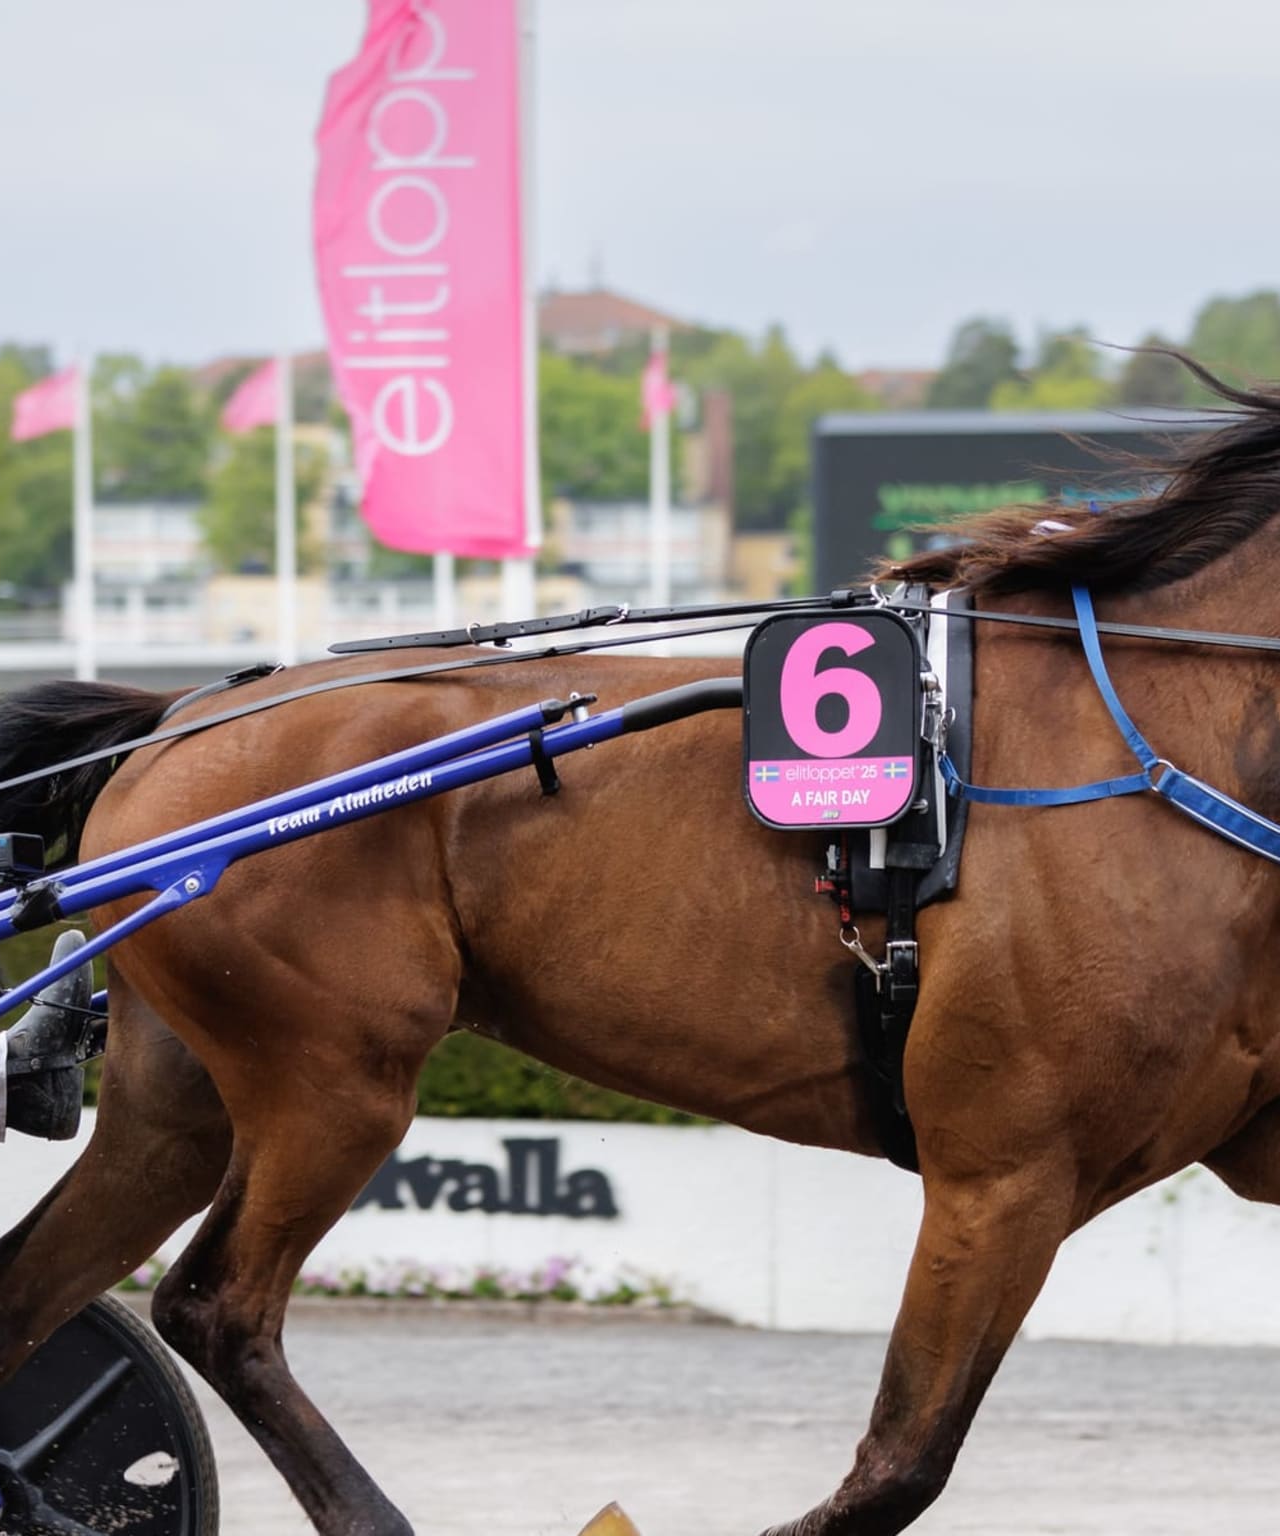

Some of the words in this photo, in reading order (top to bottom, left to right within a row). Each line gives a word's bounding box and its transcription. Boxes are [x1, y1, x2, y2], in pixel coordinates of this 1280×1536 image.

[780, 622, 883, 759] 6
[785, 764, 856, 784] elitloppet
[791, 791, 802, 807] A
[805, 790, 838, 806] FAIR
[841, 789, 871, 805] DAY
[266, 808, 320, 836] Team
[347, 1138, 619, 1218] lvalla
